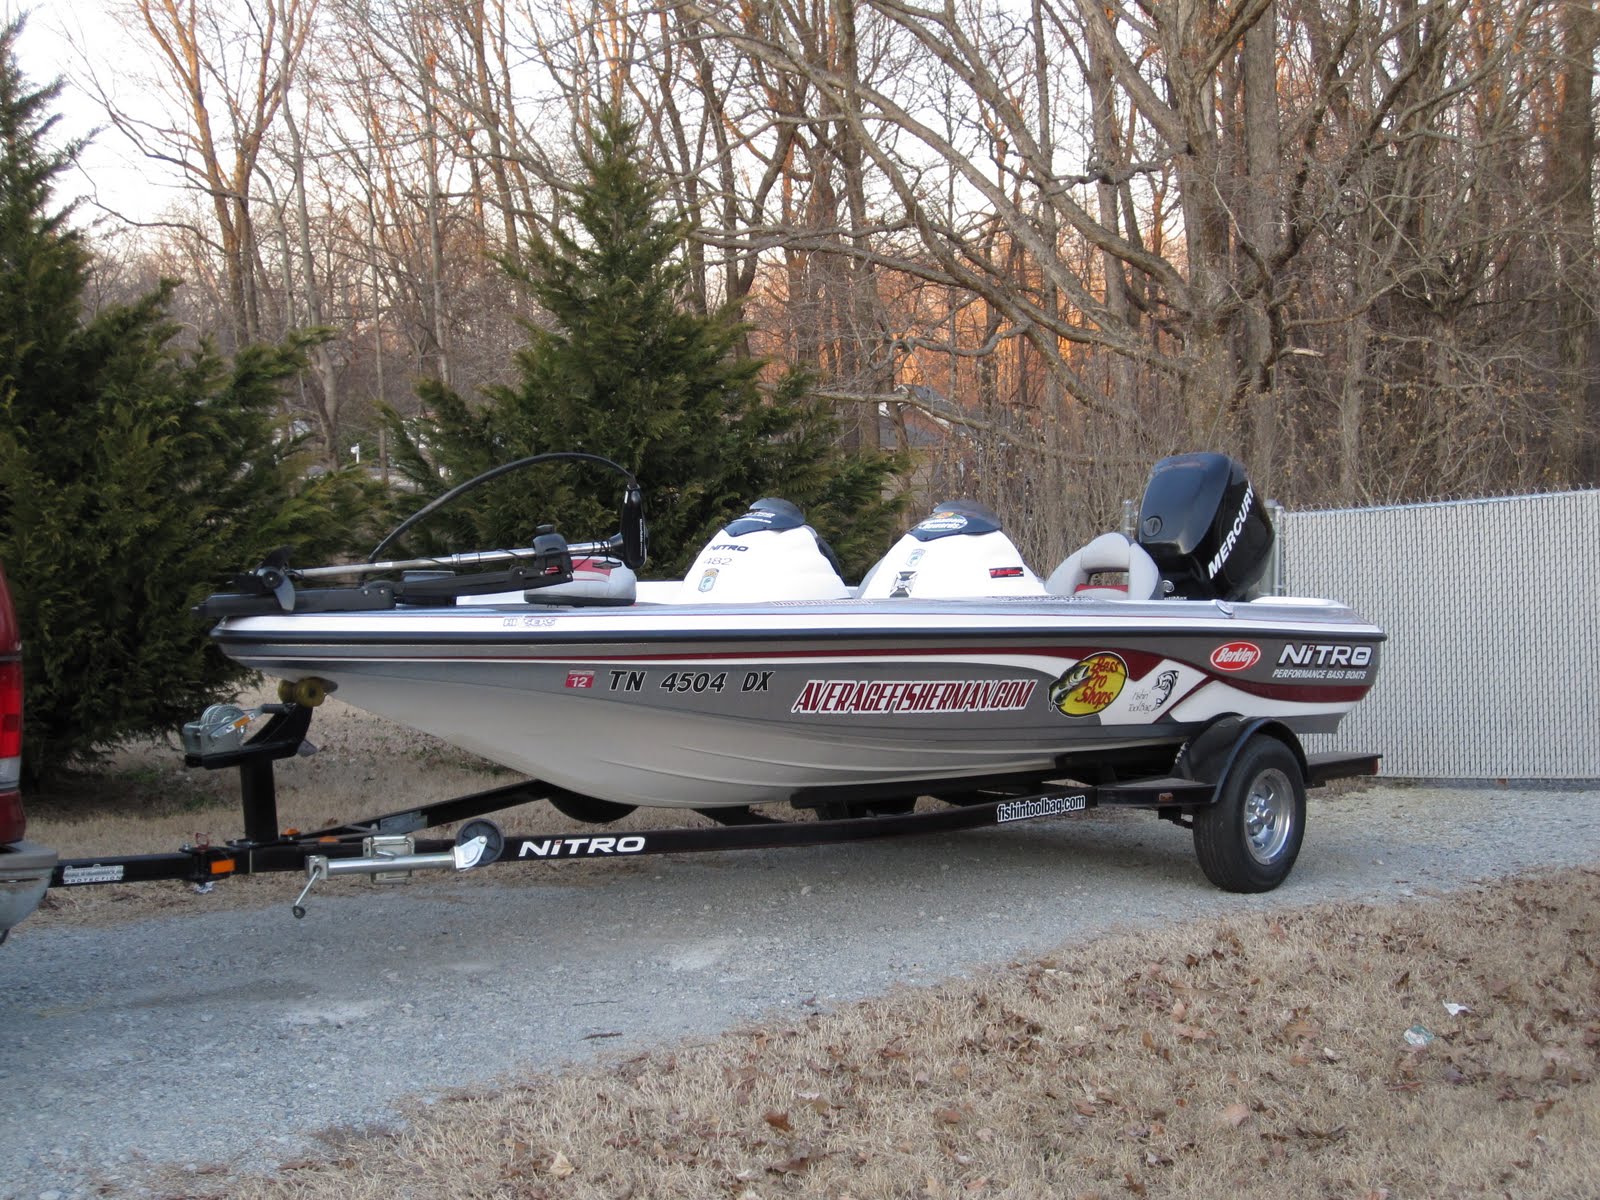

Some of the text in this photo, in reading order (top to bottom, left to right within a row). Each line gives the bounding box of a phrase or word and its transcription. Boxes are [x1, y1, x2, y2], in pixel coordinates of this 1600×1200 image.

[1208, 480, 1254, 580] MERCURY
[1090, 656, 1120, 673] Bass
[1215, 648, 1256, 666] Berkley
[571, 676, 588, 688] 12
[609, 670, 776, 693] TN 4504 DX
[1089, 672, 1108, 689] Pro
[1272, 669, 1366, 679] PERFORMANCE BASS BOATS
[791, 679, 1038, 714] AVERAGEFISHERMAN.COM
[1075, 687, 1114, 709] Shops
[997, 795, 1085, 822] fishintoolbag.com
